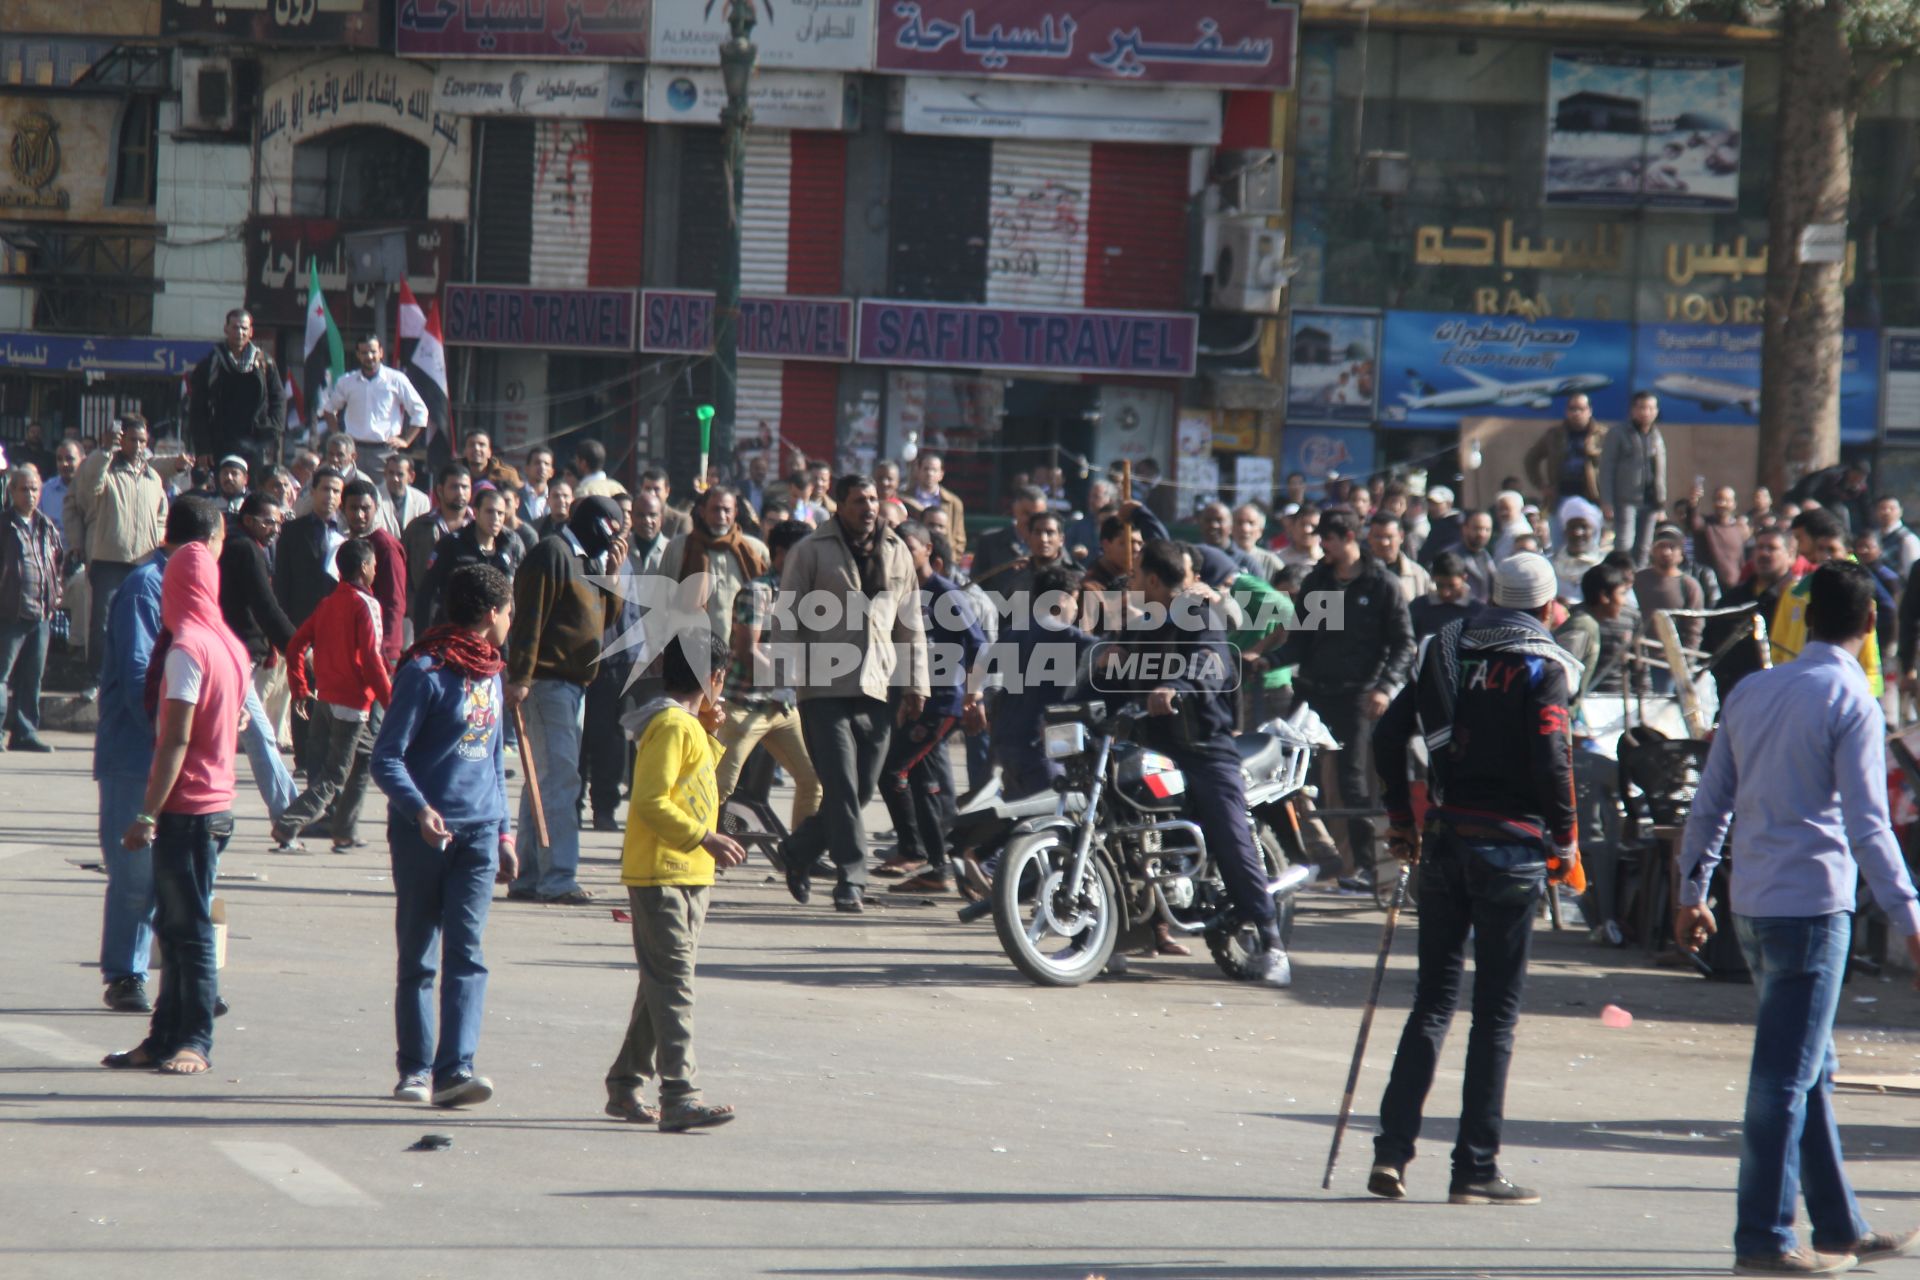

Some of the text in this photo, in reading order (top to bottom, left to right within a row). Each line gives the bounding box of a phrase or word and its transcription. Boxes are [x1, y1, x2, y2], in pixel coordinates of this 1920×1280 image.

[894, 2, 1274, 77] سفير للسياحة
[342, 68, 364, 104] الله
[407, 86, 430, 124] الله
[450, 290, 630, 346] SAFIR TRAVEL
[649, 296, 849, 354] SAFI TRAVEL
[877, 308, 1183, 369] SAFIR TRAVEL
